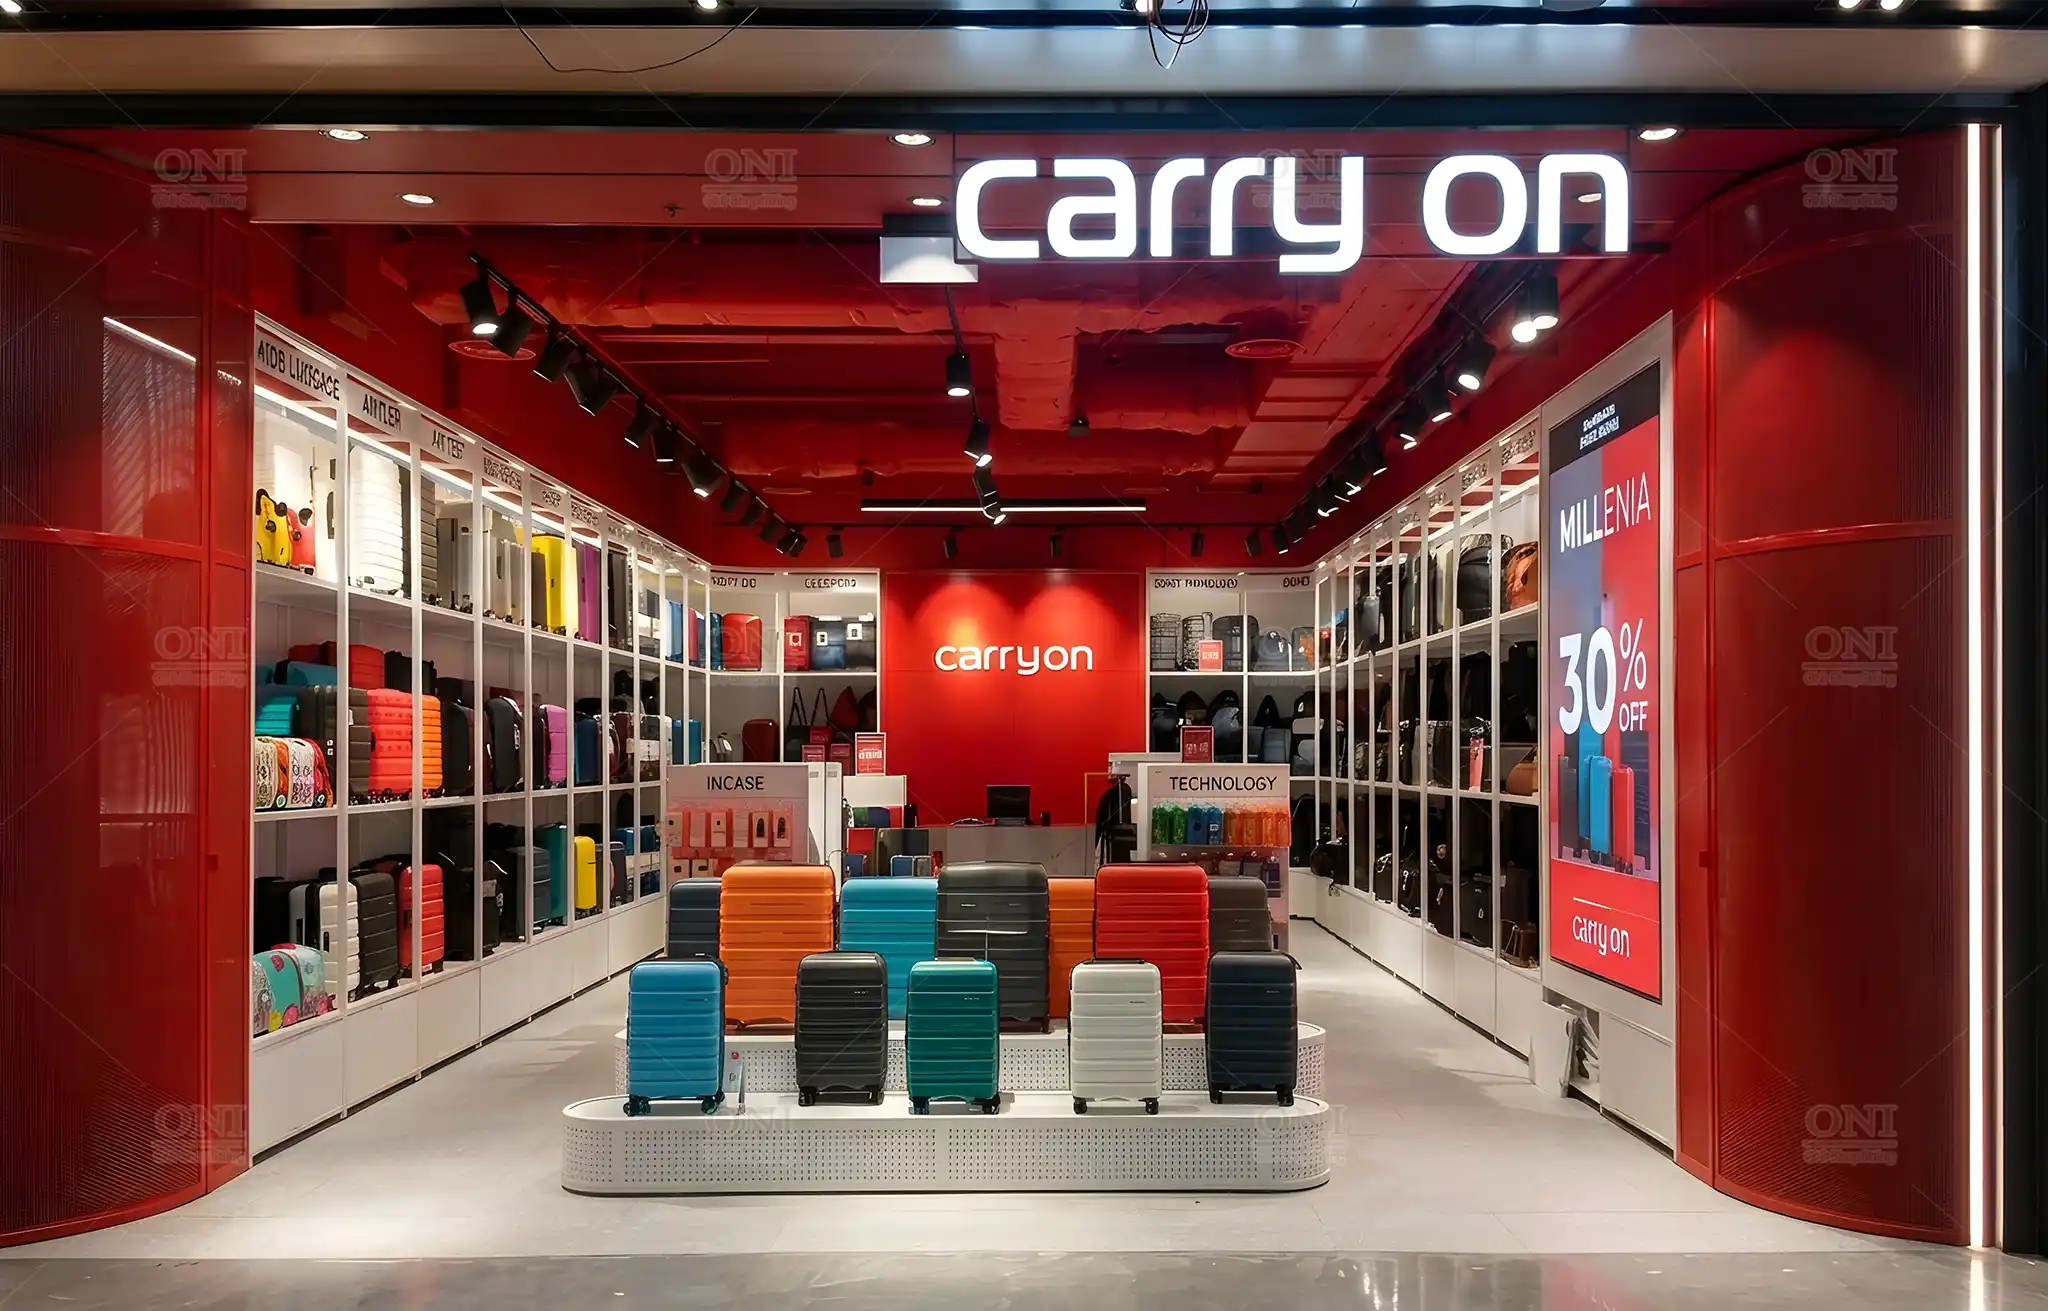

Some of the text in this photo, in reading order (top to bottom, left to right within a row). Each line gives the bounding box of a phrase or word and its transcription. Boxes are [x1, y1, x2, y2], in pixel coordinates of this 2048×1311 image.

[955, 153, 1630, 273] carry on
[1560, 471, 1652, 553] MILLENIA
[934, 645, 1094, 676] carryon
[1618, 700, 1649, 733] OFF
[706, 775, 765, 791] INCASE
[1169, 776, 1278, 792] TECHNOLOGY
